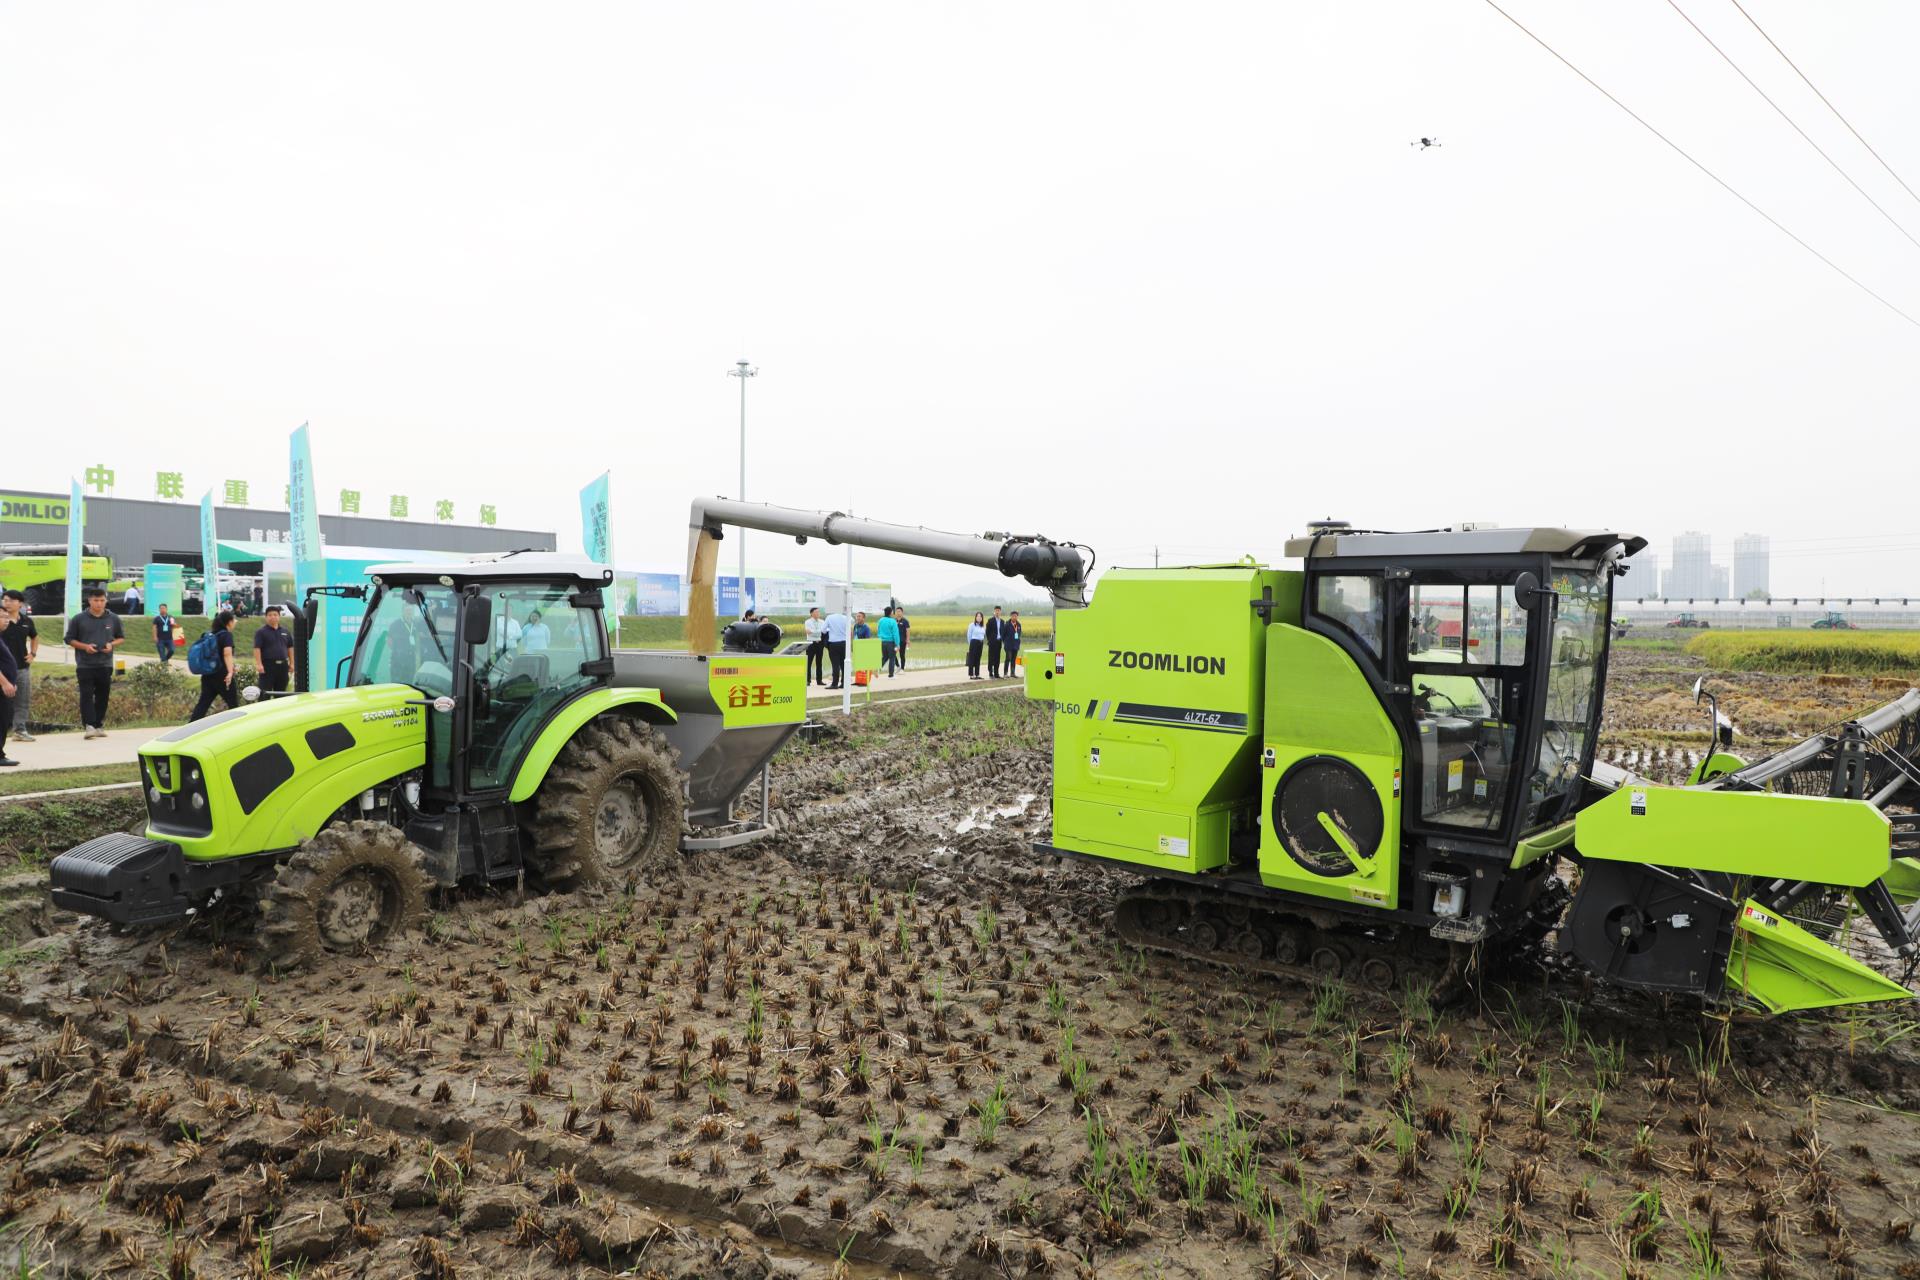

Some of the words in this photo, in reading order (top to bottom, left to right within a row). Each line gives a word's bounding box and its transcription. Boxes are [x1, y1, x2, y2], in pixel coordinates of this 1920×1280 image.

[0, 501, 70, 520] OMLIO
[1108, 650, 1226, 675] ZOOMLION
[728, 685, 772, 708] 谷王
[362, 707, 418, 723] ZOOMLION
